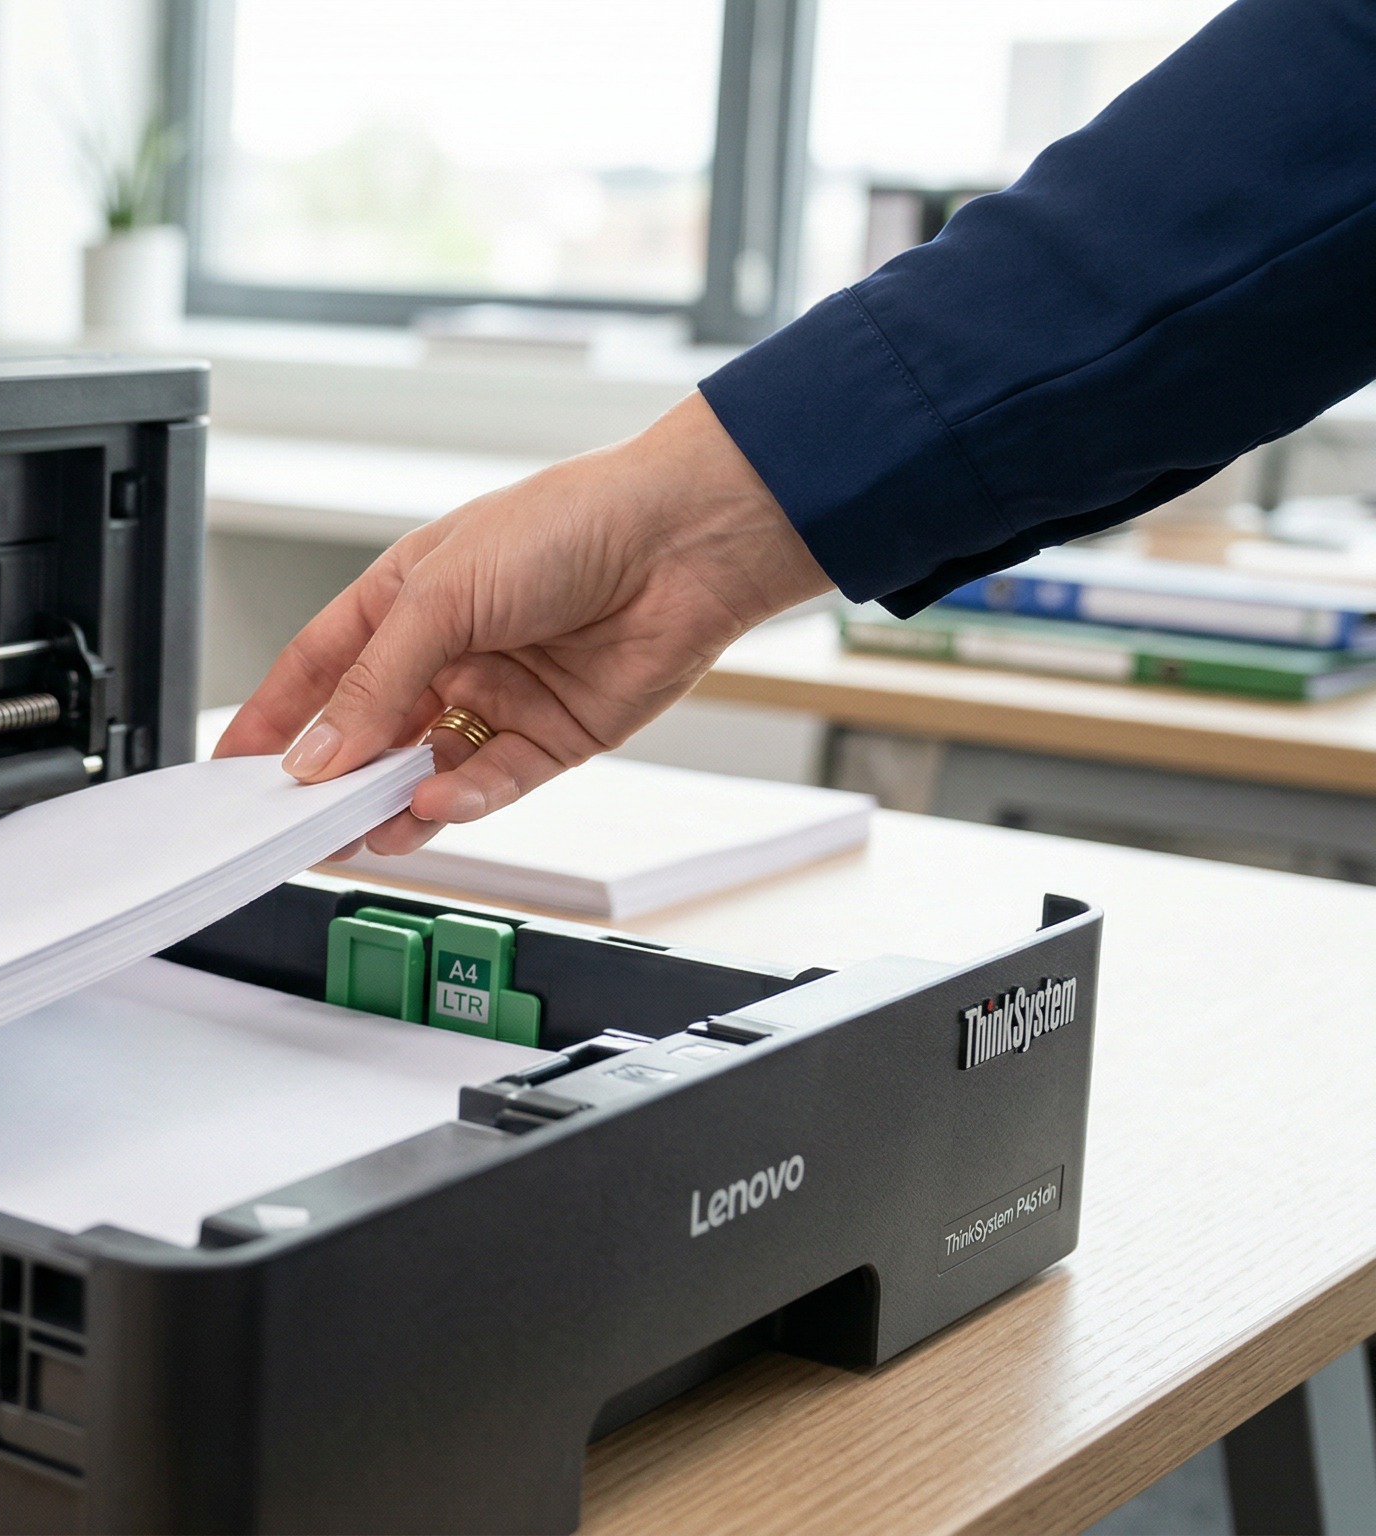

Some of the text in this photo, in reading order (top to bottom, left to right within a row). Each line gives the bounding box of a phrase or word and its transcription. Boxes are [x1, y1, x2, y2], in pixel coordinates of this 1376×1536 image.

[449, 960, 478, 984] A4
[443, 990, 483, 1016] LTR
[964, 976, 1077, 1069] ThinkSystem
[690, 1154, 805, 1238] Lenovo
[944, 1207, 1014, 1256] ThinkSystem
